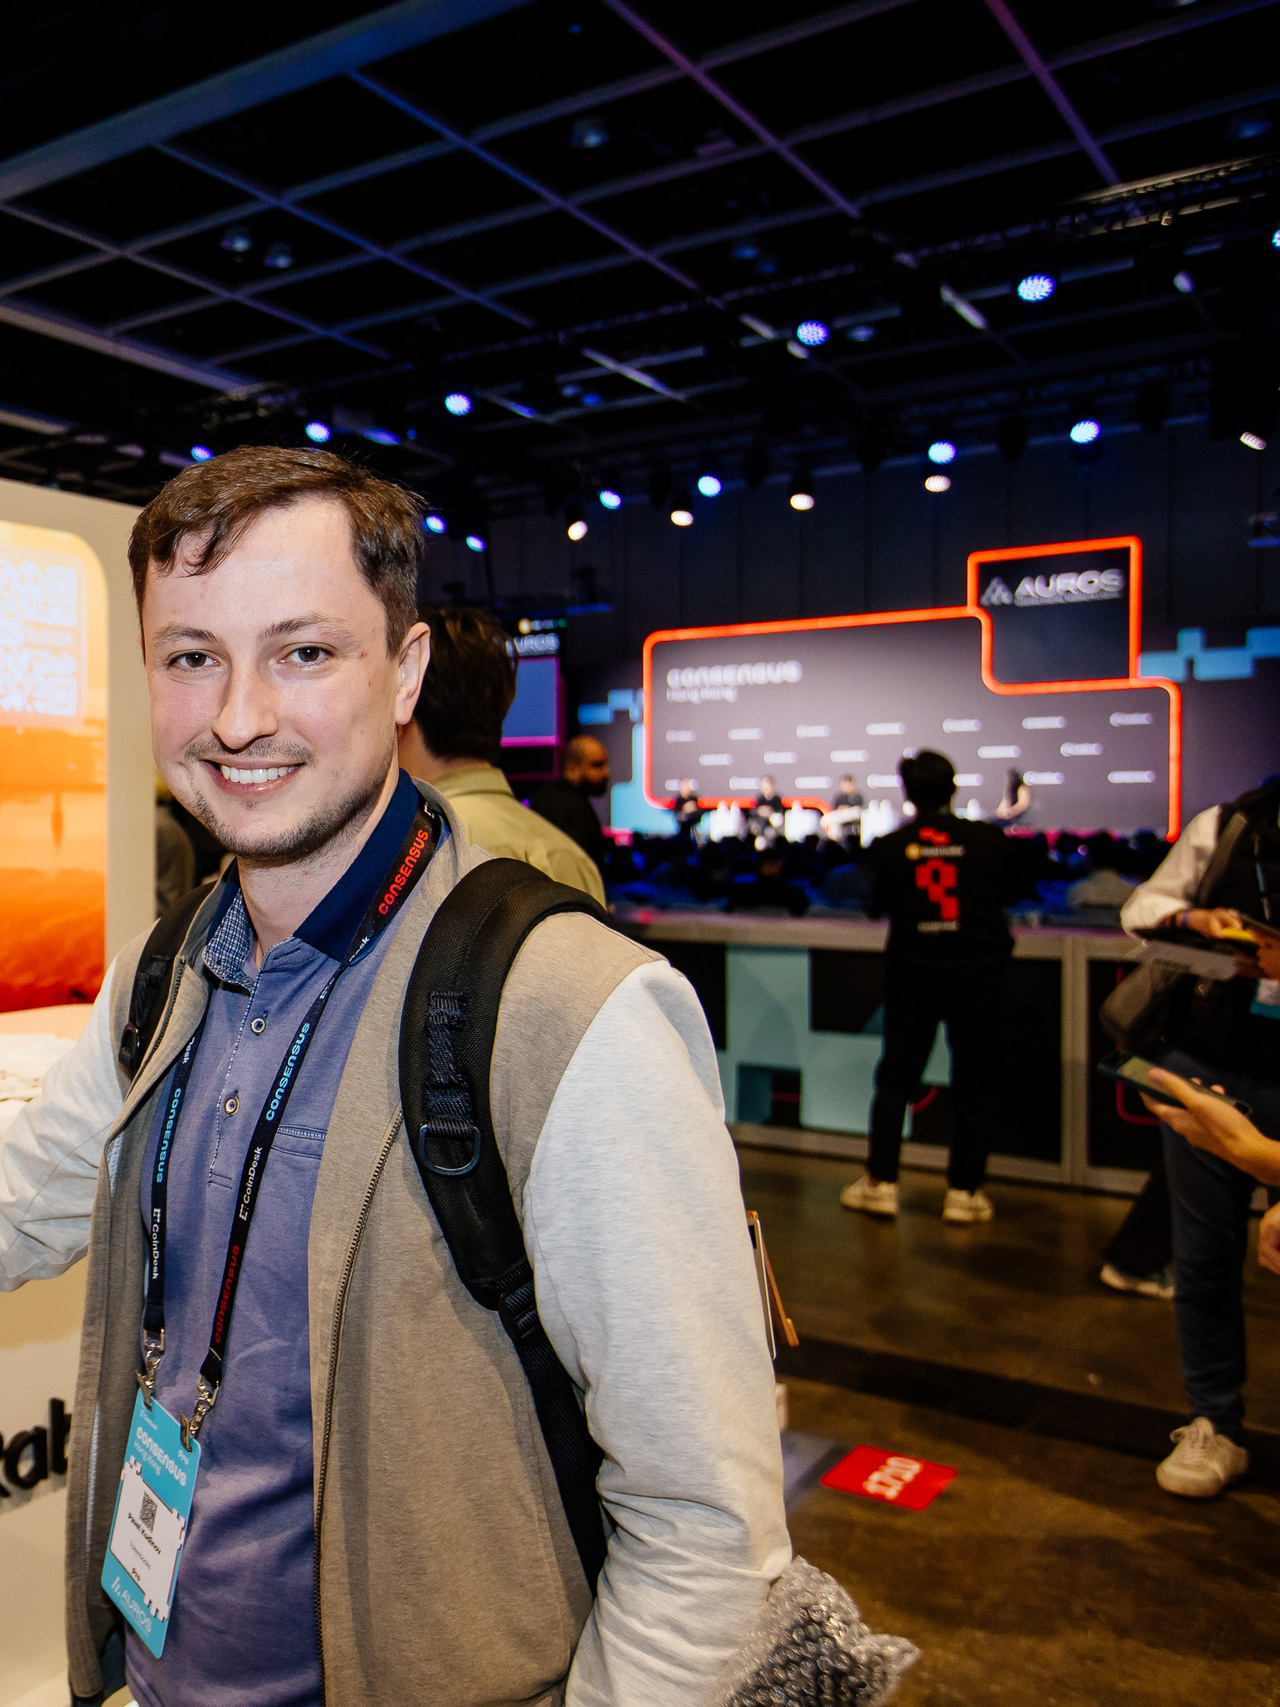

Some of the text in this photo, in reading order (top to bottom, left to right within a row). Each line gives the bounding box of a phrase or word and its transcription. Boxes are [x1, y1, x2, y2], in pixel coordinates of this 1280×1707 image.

[1014, 568, 1125, 600] AUROS
[244, 1146, 263, 1204] CoinDesk
[121, 1589, 152, 1633] AUROS
